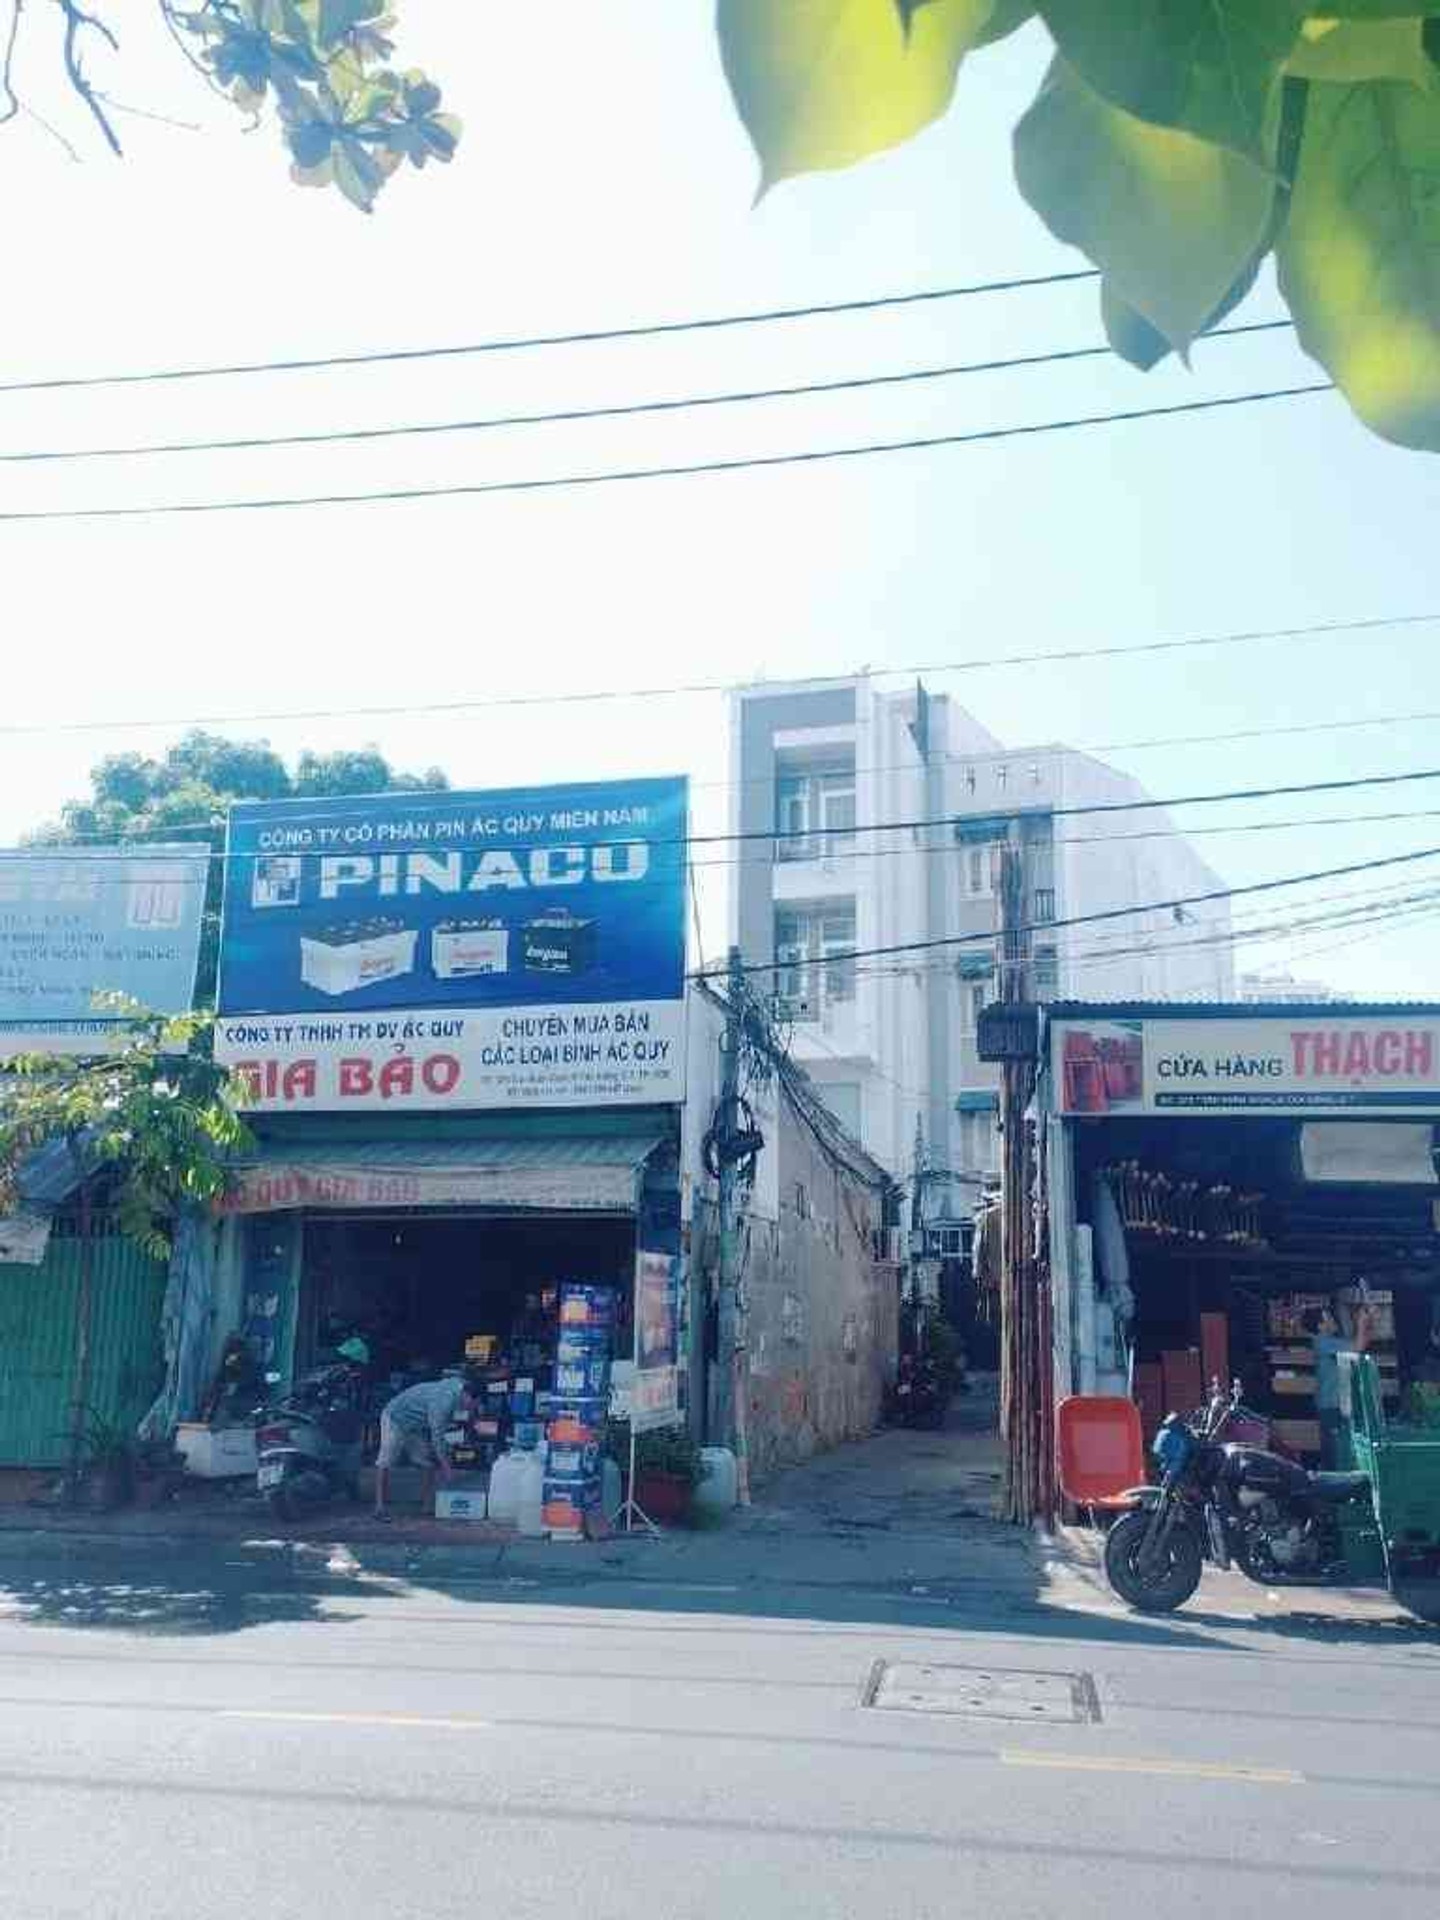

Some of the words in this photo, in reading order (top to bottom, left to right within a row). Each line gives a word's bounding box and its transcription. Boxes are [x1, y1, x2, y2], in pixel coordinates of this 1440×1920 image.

[316, 827, 340, 845] TY
[433, 818, 465, 838] PIN
[603, 806, 649, 827] NAM
[319, 839, 650, 899] PINACO
[273, 1024, 294, 1043] TY
[300, 1021, 343, 1043] TNHH
[348, 1023, 372, 1041] TM
[376, 1021, 399, 1039] DV
[1214, 1053, 1284, 1078] HÀNG
[1290, 1030, 1433, 1086] THẠCH
[339, 1043, 460, 1099] BẢO
